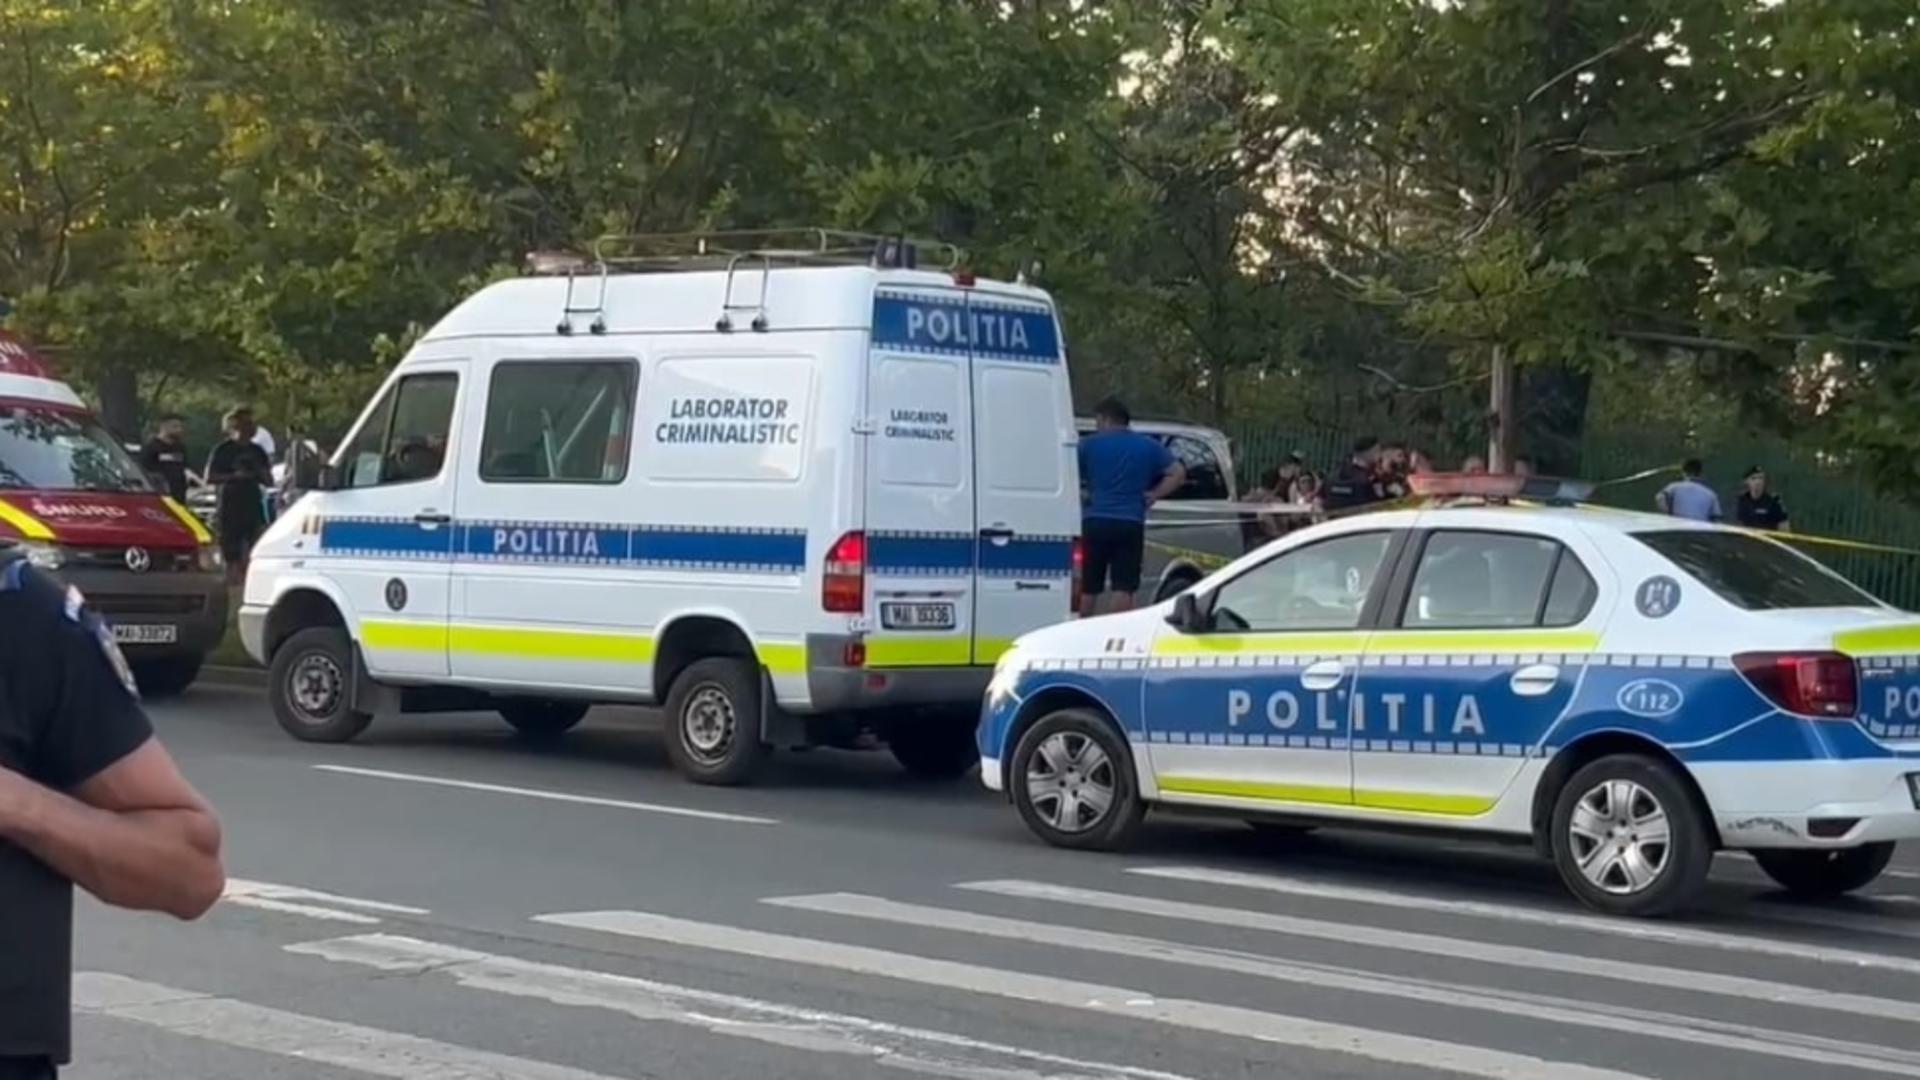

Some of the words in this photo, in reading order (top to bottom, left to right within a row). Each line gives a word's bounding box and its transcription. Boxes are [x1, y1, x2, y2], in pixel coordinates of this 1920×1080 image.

[906, 308, 1030, 350] POLITIA
[670, 398, 788, 420] LABORATOR
[655, 421, 799, 445] CRIMINALISTIC
[492, 529, 600, 556] POLITIA
[1227, 689, 1486, 736] POLITIA
[1640, 693, 1670, 710] 112
